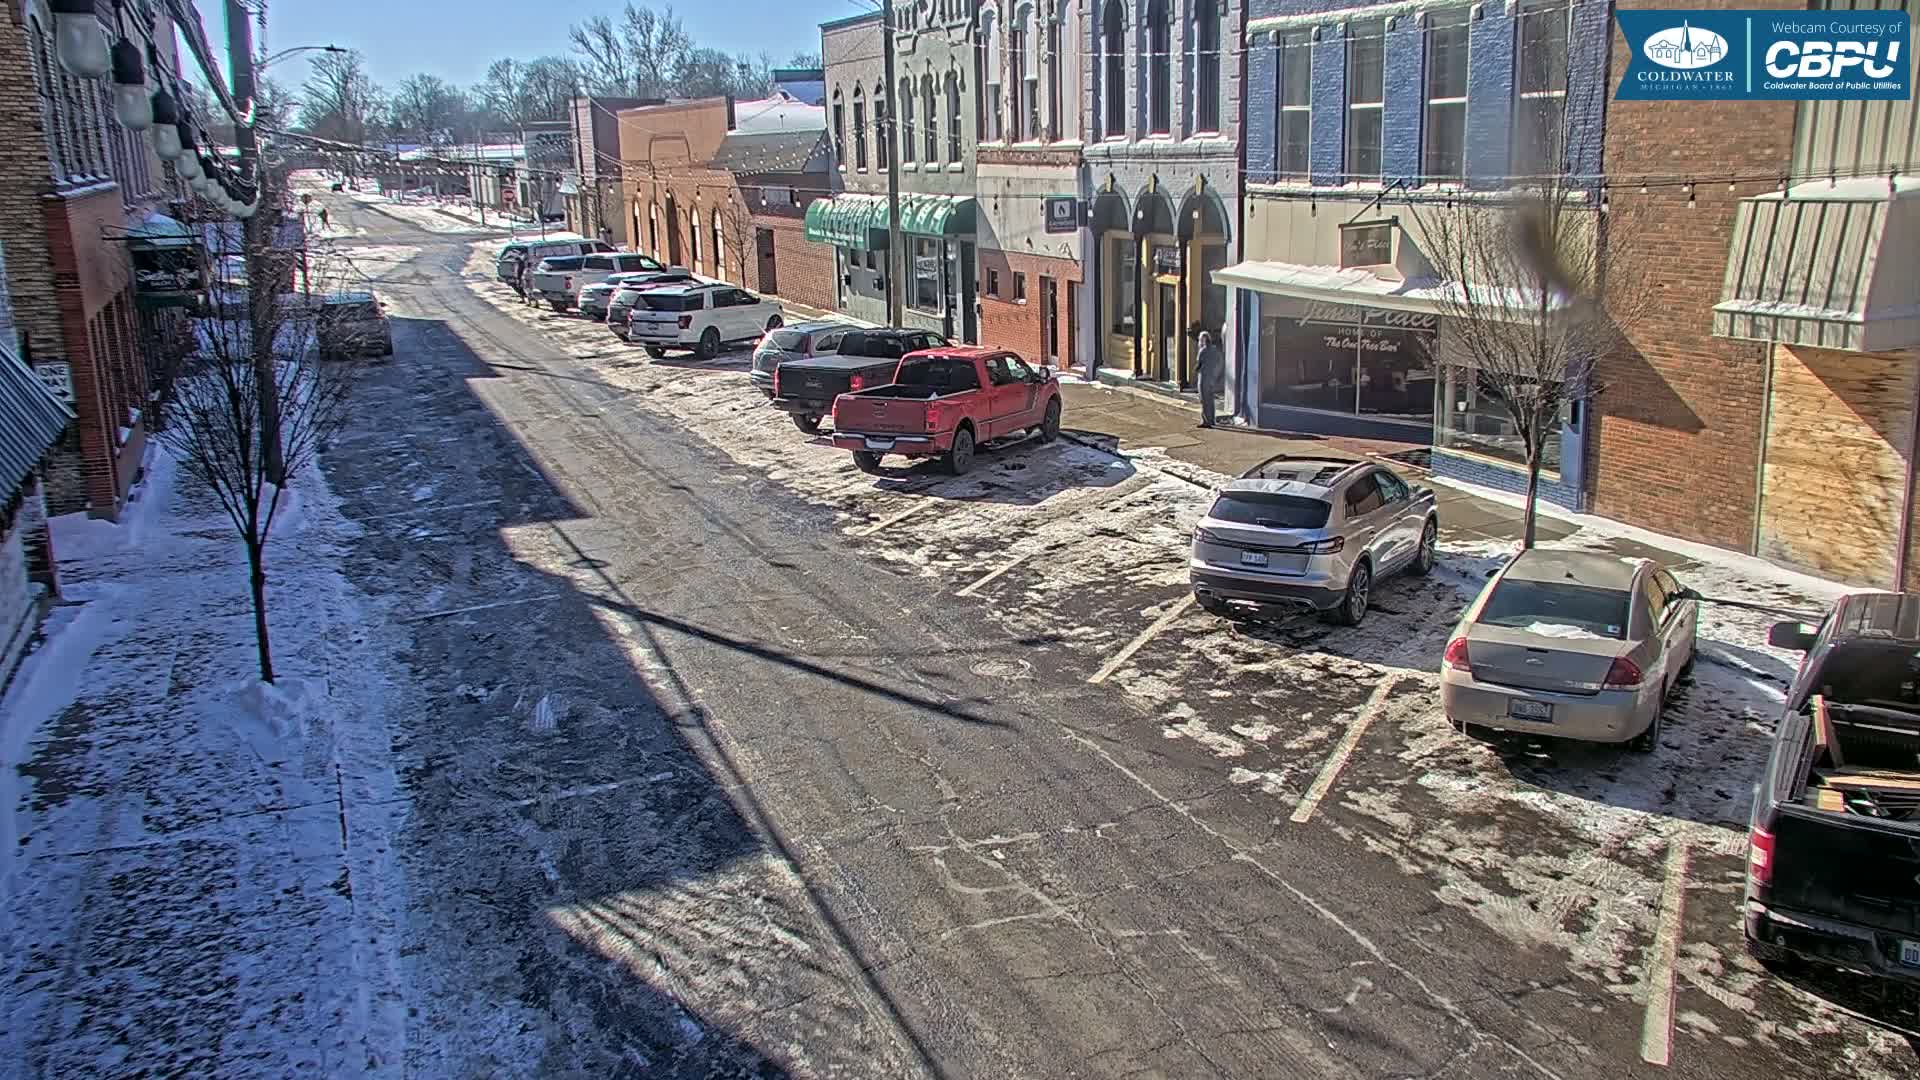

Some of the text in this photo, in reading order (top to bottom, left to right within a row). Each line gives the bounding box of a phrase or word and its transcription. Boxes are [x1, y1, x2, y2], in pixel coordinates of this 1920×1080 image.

[1363, 309, 1437, 328] Place
[1337, 327, 1383, 338] HOME OF
[39, 367, 65, 377] ONE
